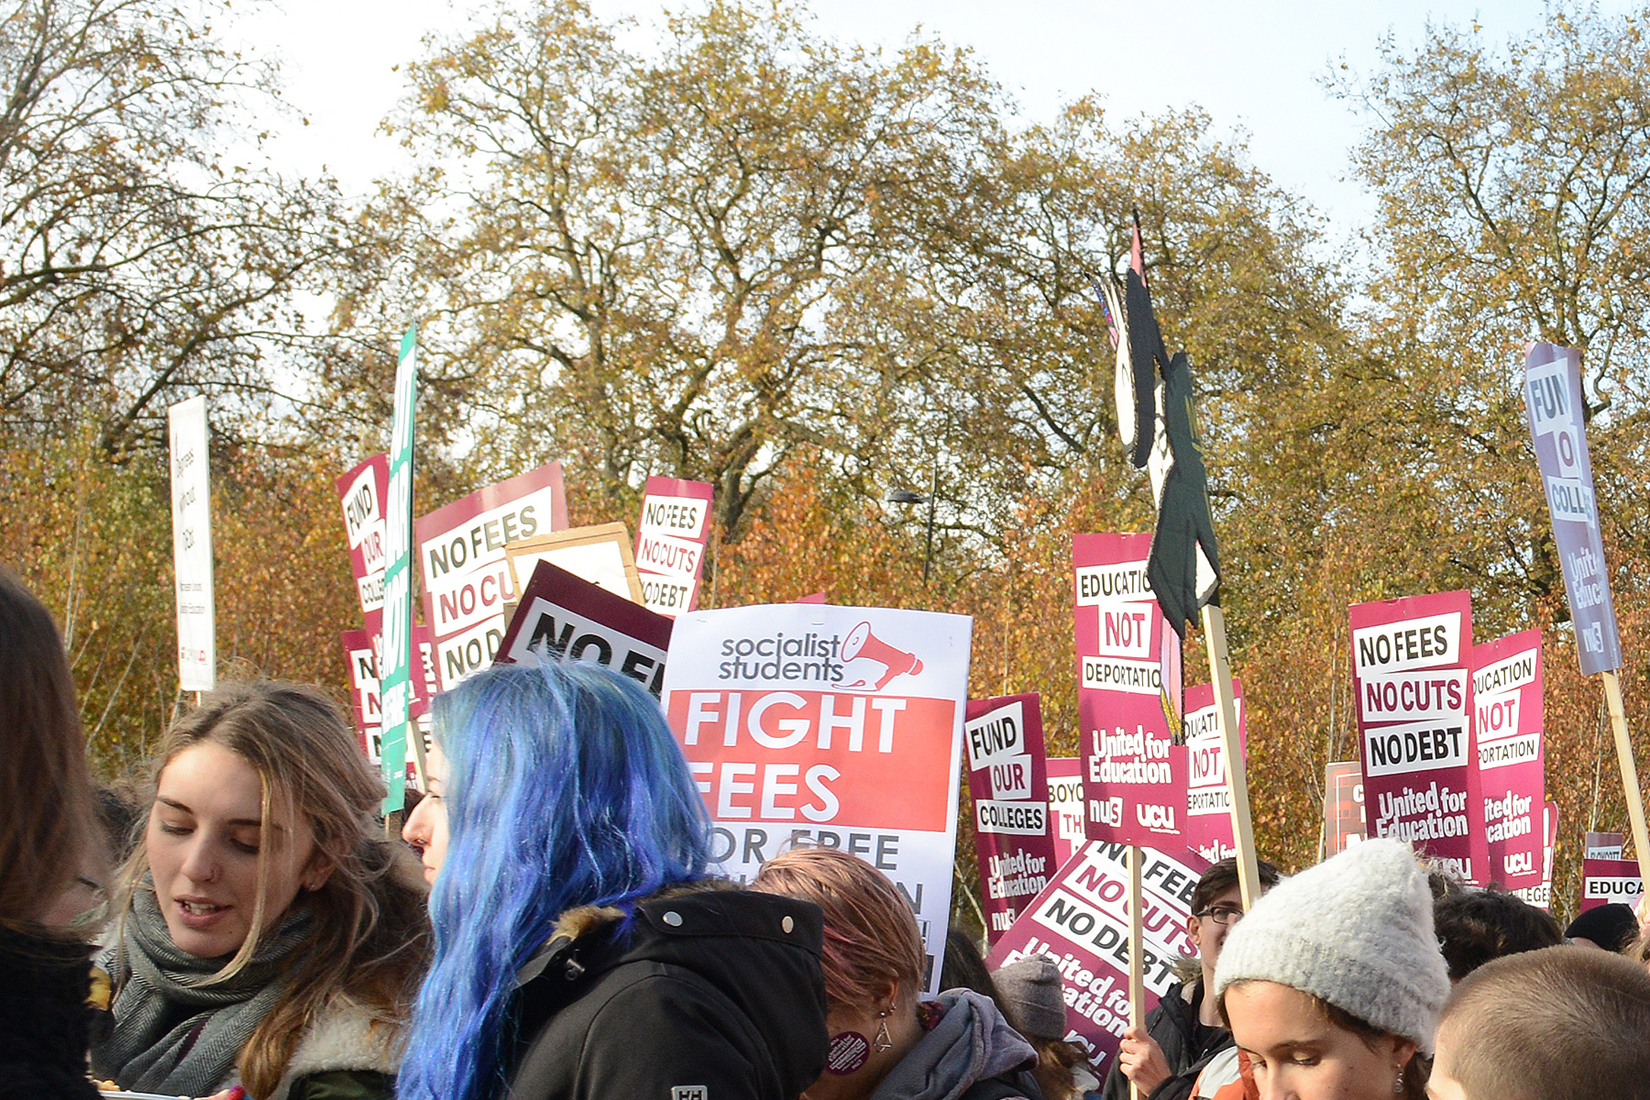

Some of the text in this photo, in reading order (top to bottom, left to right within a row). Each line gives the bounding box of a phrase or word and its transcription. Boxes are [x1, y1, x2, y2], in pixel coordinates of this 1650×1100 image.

[1530, 373, 1571, 422] FUN
[645, 503, 698, 531] NO FEES
[429, 505, 538, 579] NO FEES
[641, 540, 696, 573] NO CUTS
[1567, 548, 1598, 582] Unit
[439, 571, 517, 624] NO CU
[652, 584, 688, 609] DEBT
[1080, 568, 1151, 598] EDUCATIO
[721, 632, 841, 659] socialist
[1104, 611, 1146, 648] NOT
[1359, 624, 1448, 668] NO FEES
[445, 637, 483, 680] NO
[718, 656, 844, 683] students
[1085, 662, 1161, 689] DEPORTATIO
[1472, 656, 1532, 697] DUCATION
[1366, 678, 1463, 713] NO CUTS
[684, 691, 907, 753] FIGHT
[1184, 711, 1219, 740] DUCATI
[1478, 699, 1516, 735] NOT
[969, 715, 1018, 760] FUND
[1092, 724, 1172, 759] United for
[1370, 726, 1463, 767] NO DEBT
[1478, 739, 1535, 764] PORTATION
[993, 765, 1026, 792] OUR
[1088, 755, 1172, 785] Education
[1192, 746, 1221, 779] NOT
[1088, 797, 1123, 828] nus
[1187, 791, 1230, 810] EPORTATIO
[1379, 781, 1438, 821] United
[1441, 787, 1467, 812] for
[1483, 789, 1532, 822] ited for
[979, 806, 1044, 830] COLLEGES
[1063, 813, 1083, 834] TH
[1375, 809, 1469, 842] Education
[1486, 815, 1532, 844] cation
[704, 827, 769, 864] OR
[988, 848, 1046, 878] United for
[987, 874, 1047, 900] Education
[1075, 864, 1125, 903] NO
[1143, 860, 1197, 907] FEE
[1589, 880, 1645, 895] EDUCA
[1044, 898, 1175, 987] NO DEBT
[1109, 991, 1131, 1020] fo
[1064, 1029, 1108, 1067] nu
